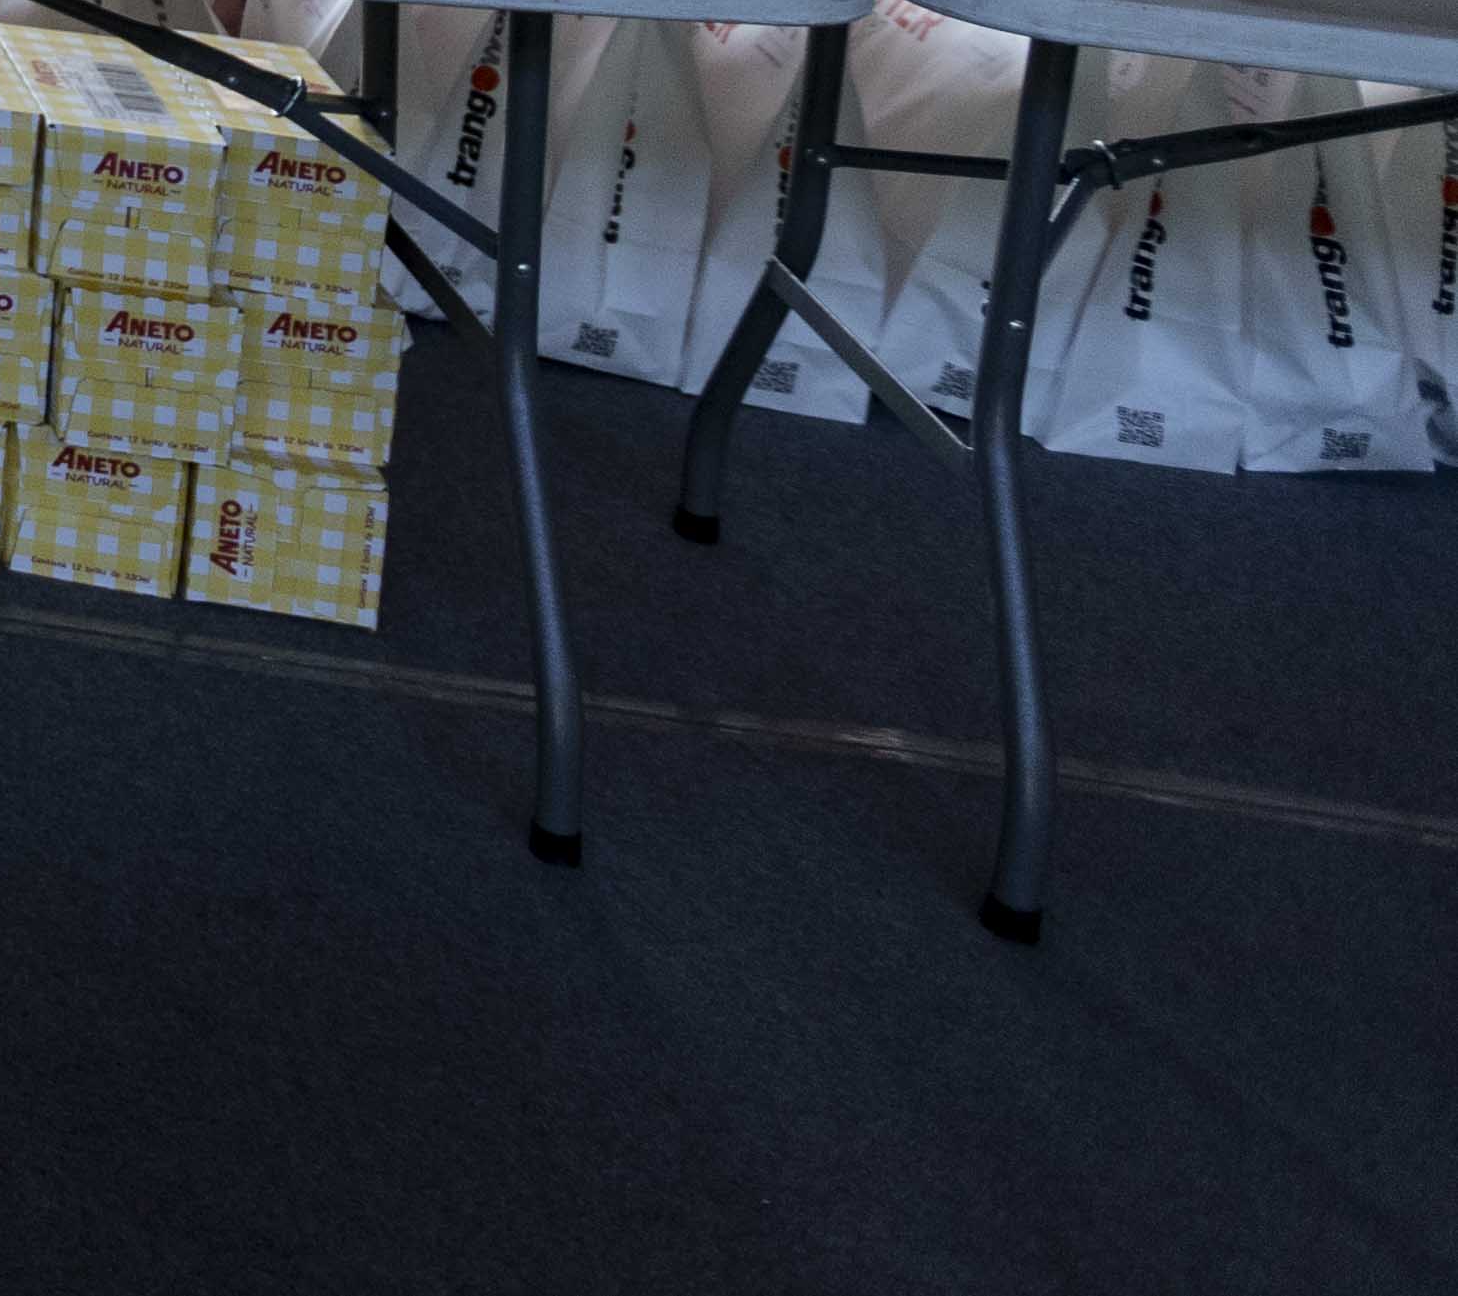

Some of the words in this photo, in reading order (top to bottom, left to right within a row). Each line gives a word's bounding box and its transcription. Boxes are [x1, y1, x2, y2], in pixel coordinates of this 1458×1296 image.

[93, 151, 183, 185] ANETO
[255, 150, 346, 185] ANETO
[274, 179, 331, 196] NATURAL
[104, 310, 193, 342] ANETO
[268, 314, 357, 345] ANETO
[288, 339, 342, 355] NATURAL
[53, 444, 141, 479] ANETO
[210, 500, 241, 574] ANETO
